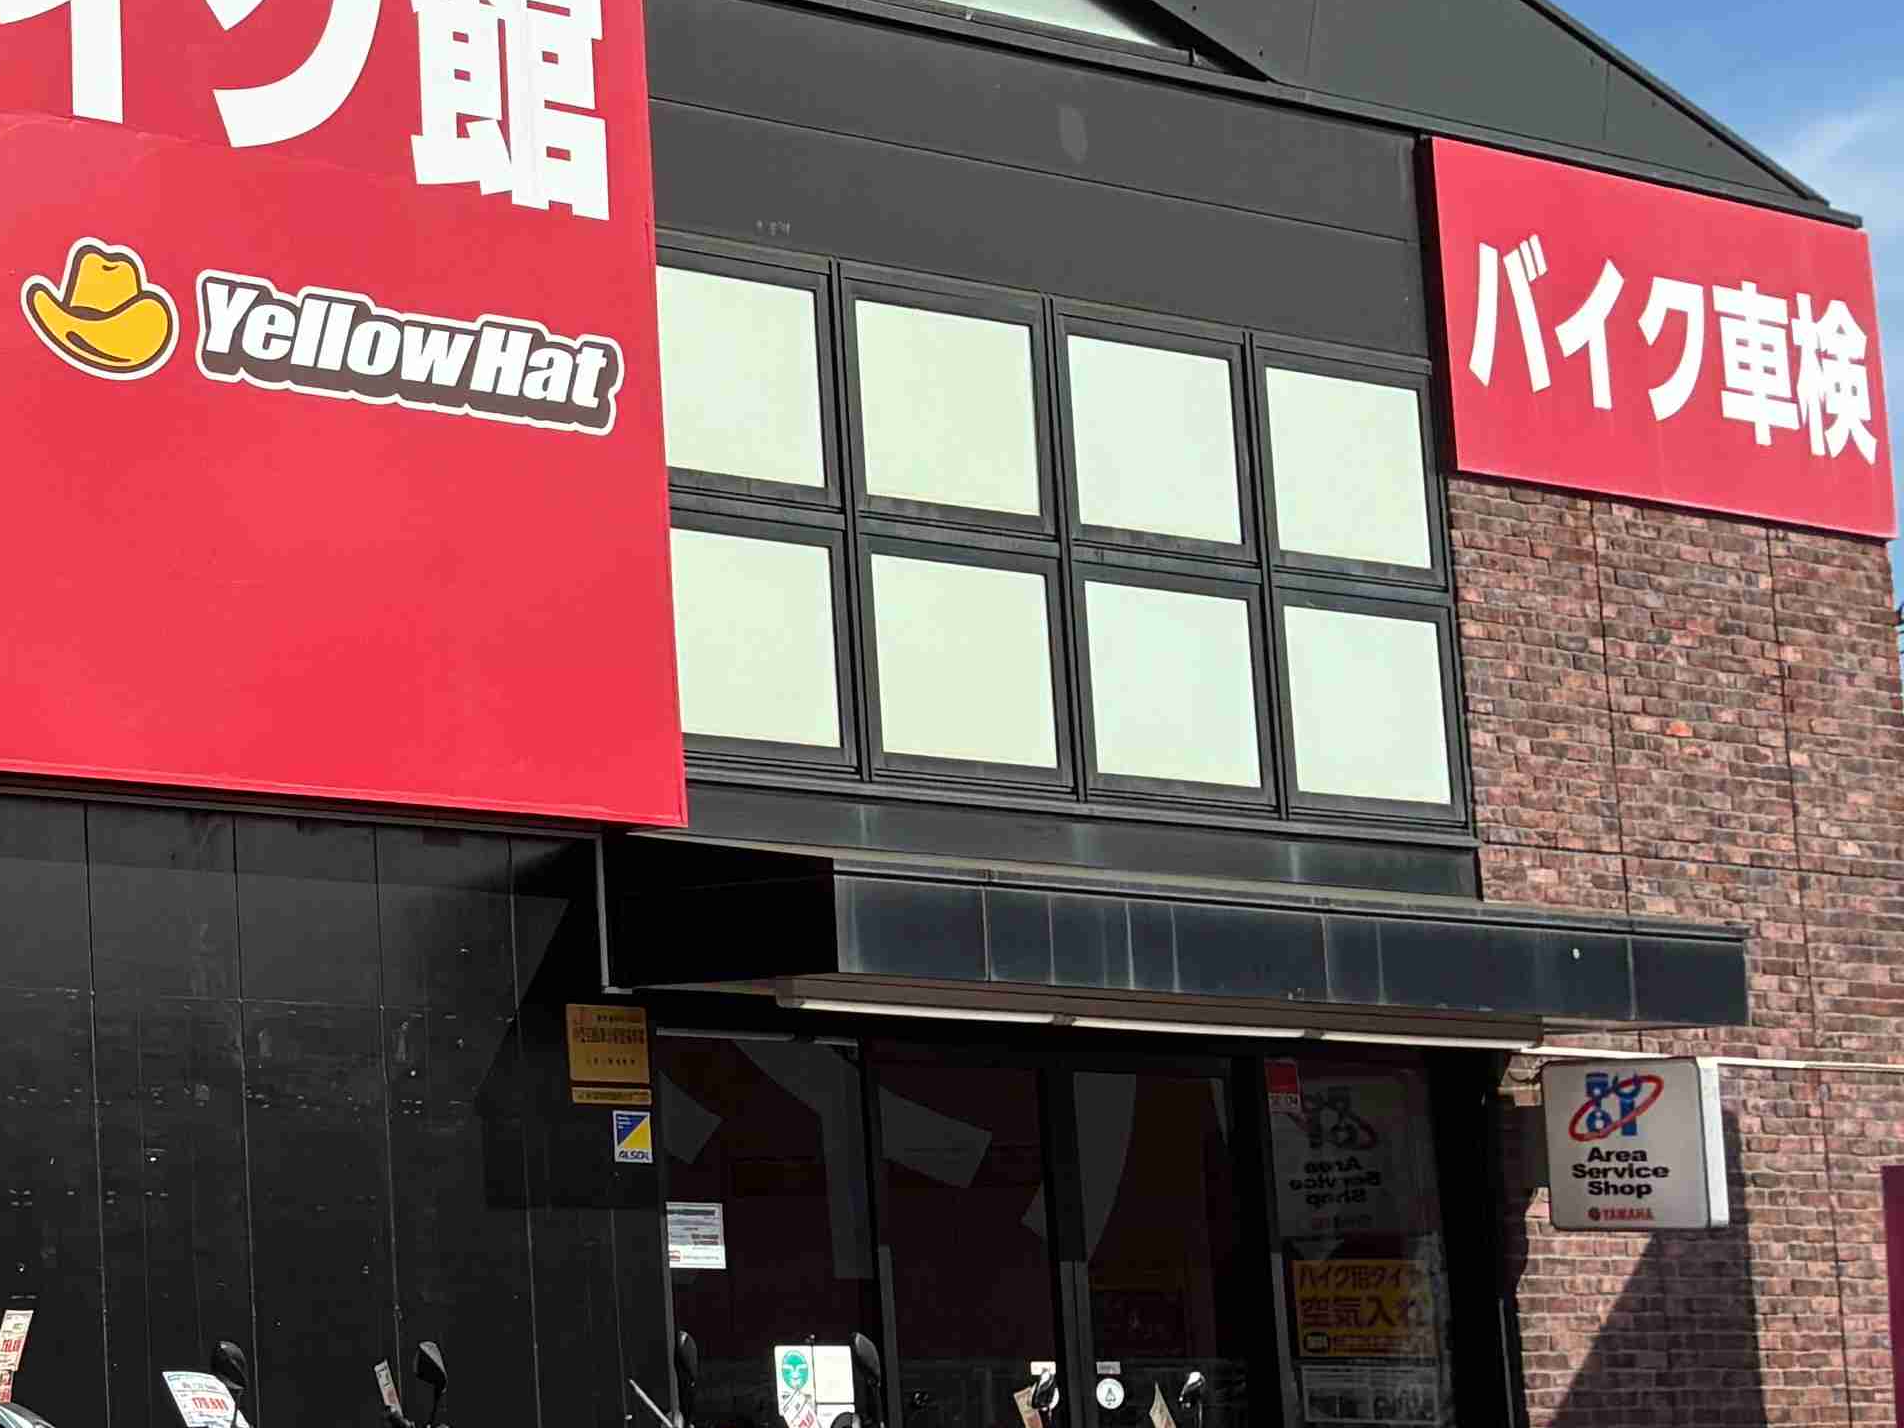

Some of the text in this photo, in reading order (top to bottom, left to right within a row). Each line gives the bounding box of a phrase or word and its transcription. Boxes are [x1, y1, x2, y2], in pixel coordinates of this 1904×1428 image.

[1469, 234, 1877, 466] バイク車検
[1587, 1146, 1648, 1162] Area
[1571, 1163, 1671, 1179] Service
[1588, 1180, 1652, 1199] Shop
